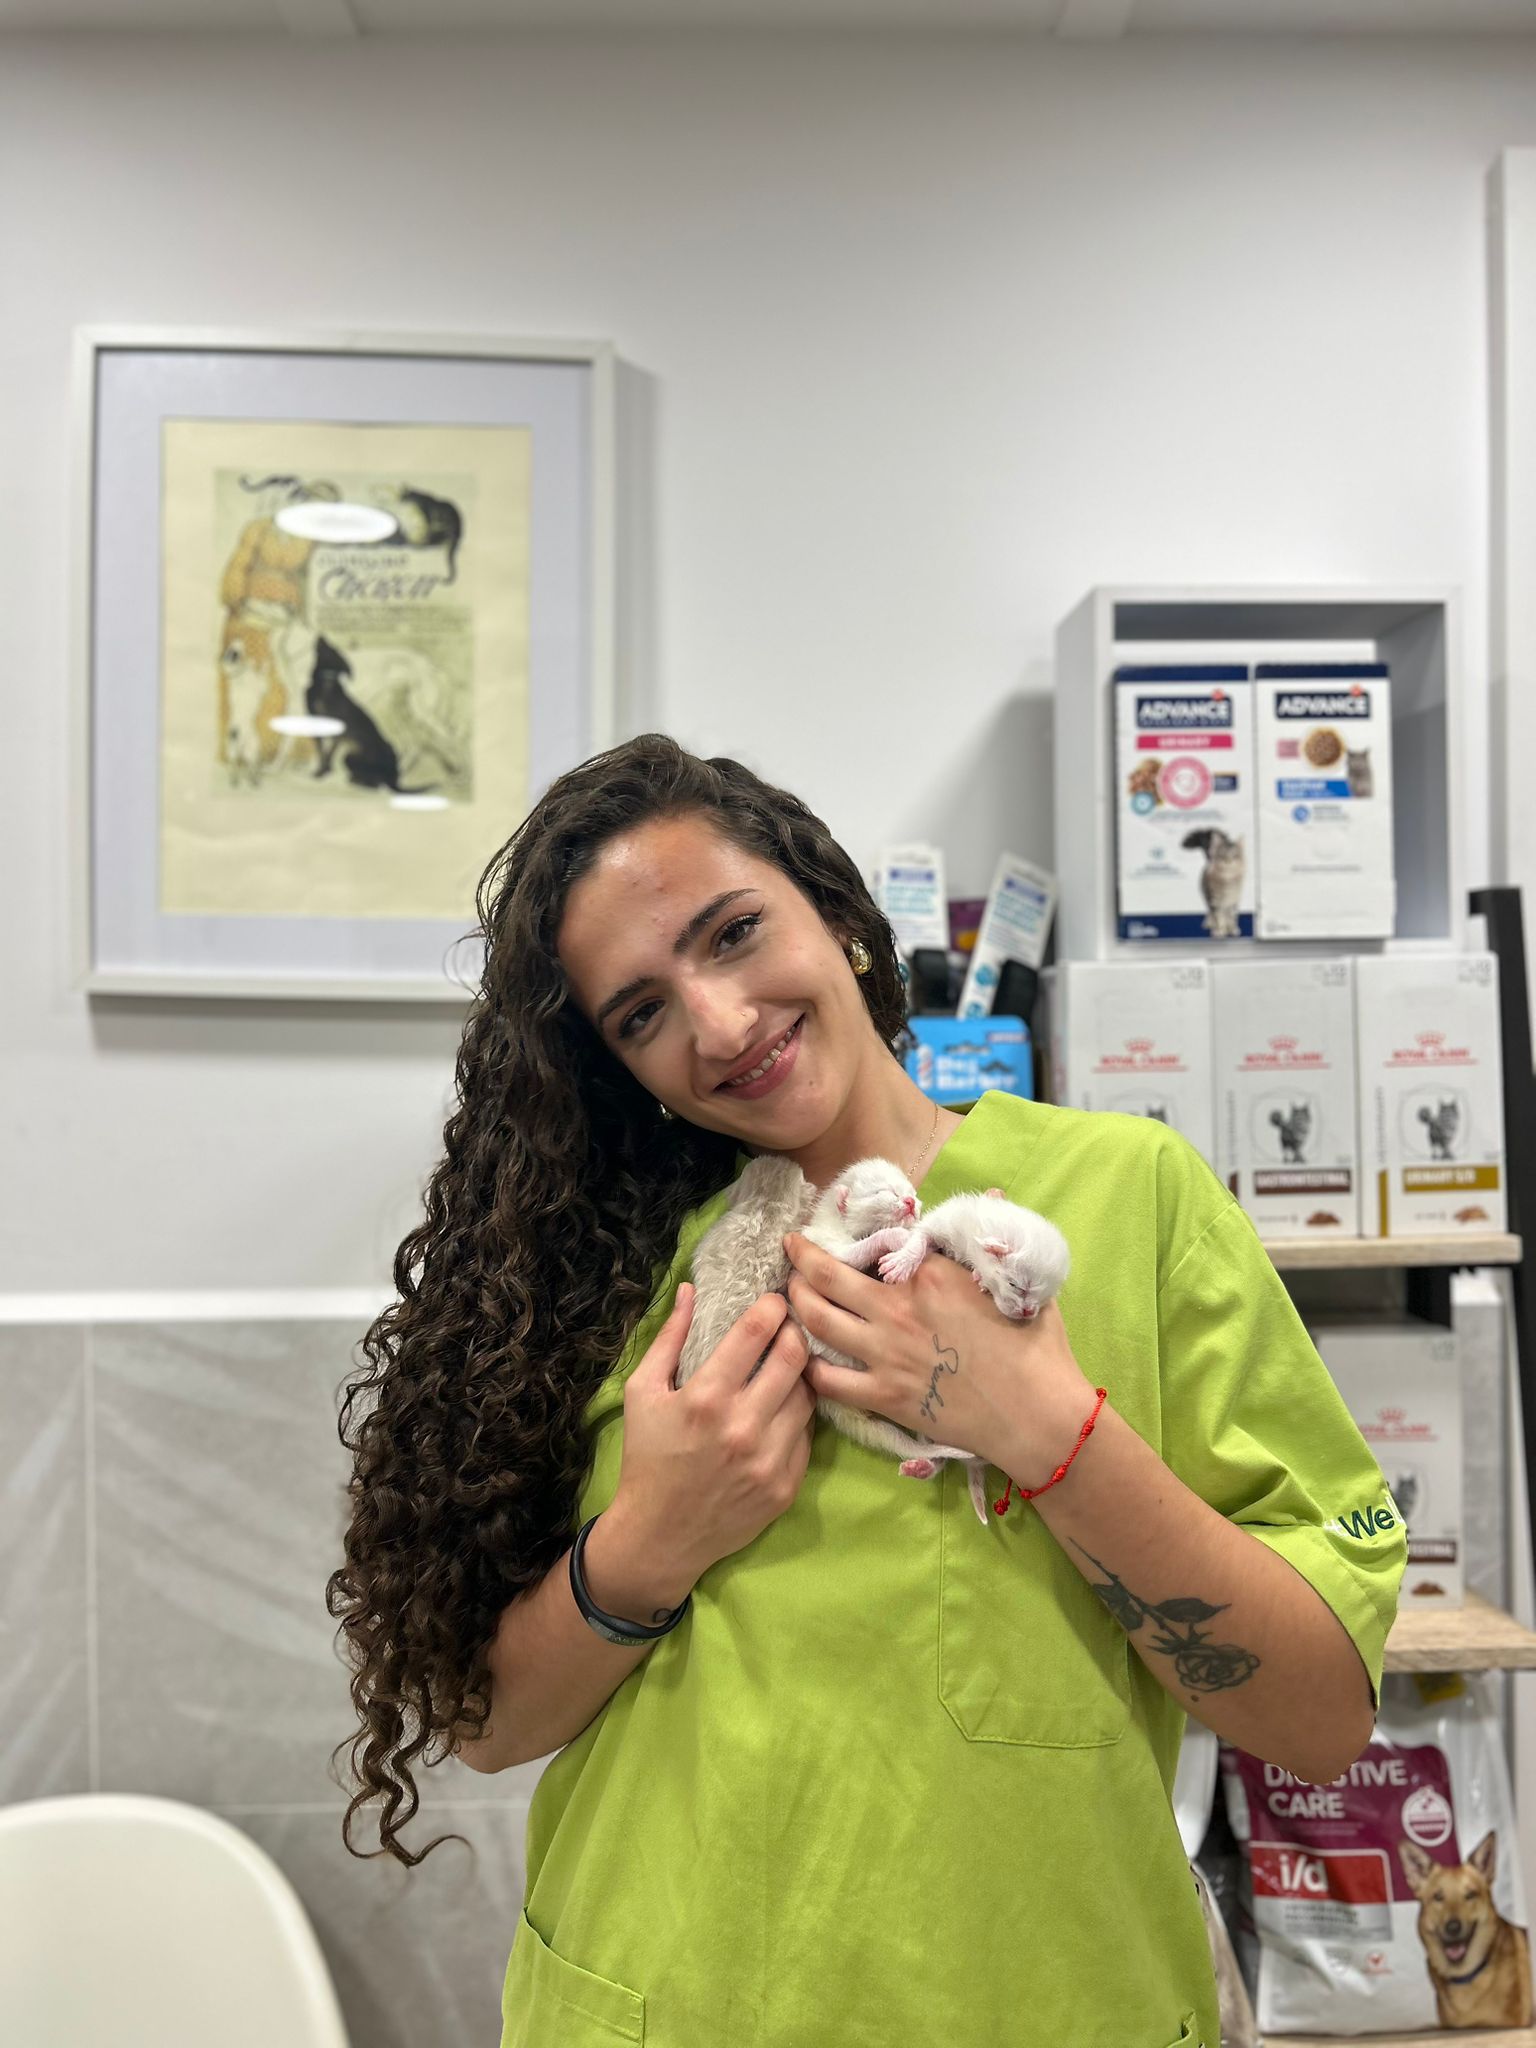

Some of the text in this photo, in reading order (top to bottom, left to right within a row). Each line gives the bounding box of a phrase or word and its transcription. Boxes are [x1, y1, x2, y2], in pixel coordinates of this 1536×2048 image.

[1140, 700, 1229, 719] ADVANCE
[1278, 696, 1367, 715] ADVANCE
[1264, 1760, 1408, 1787] DITIVE
[1268, 1791, 1346, 1819] CARE
[1280, 1854, 1329, 1892] i/d
